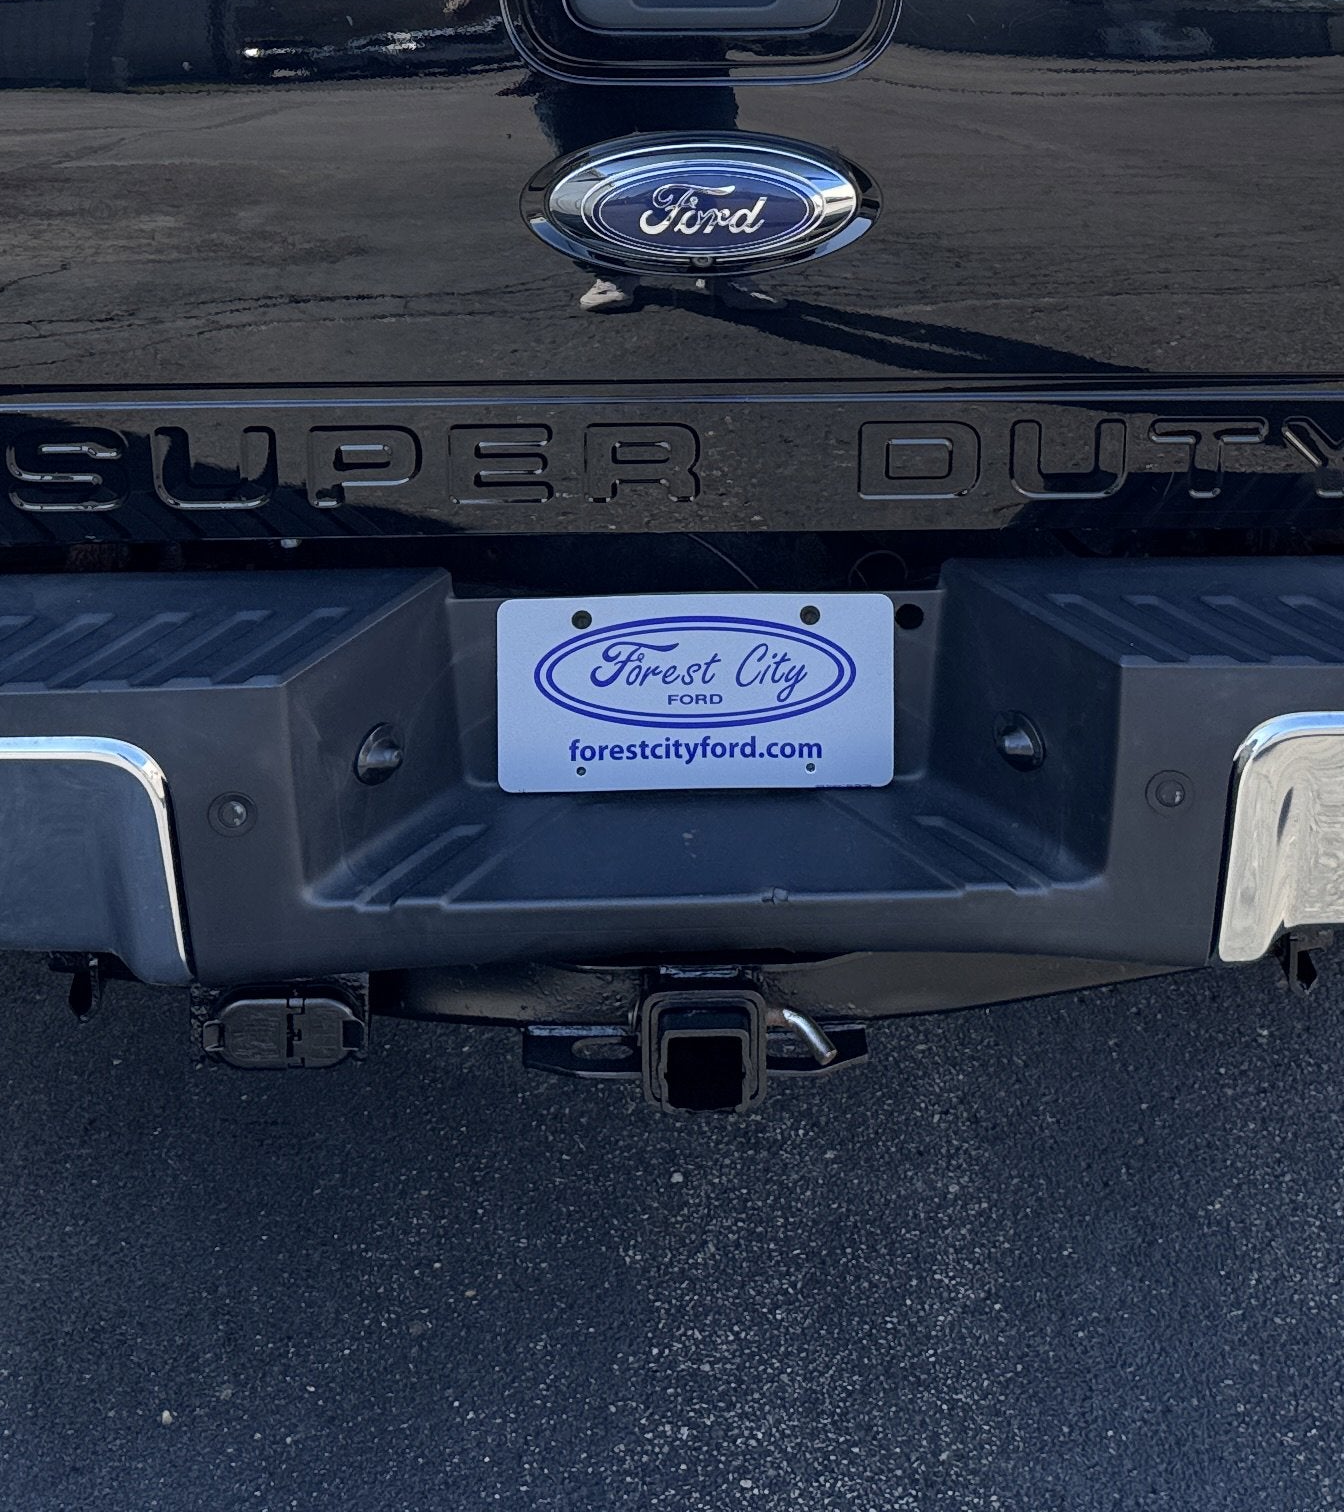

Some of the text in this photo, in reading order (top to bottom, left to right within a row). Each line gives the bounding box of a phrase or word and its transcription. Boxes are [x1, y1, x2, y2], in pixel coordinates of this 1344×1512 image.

[638, 183, 768, 235] Ford
[4, 423, 703, 513] SUPER
[590, 641, 809, 703] Forest City
[667, 694, 724, 706] FORD
[568, 735, 823, 765] forestcityford.com
